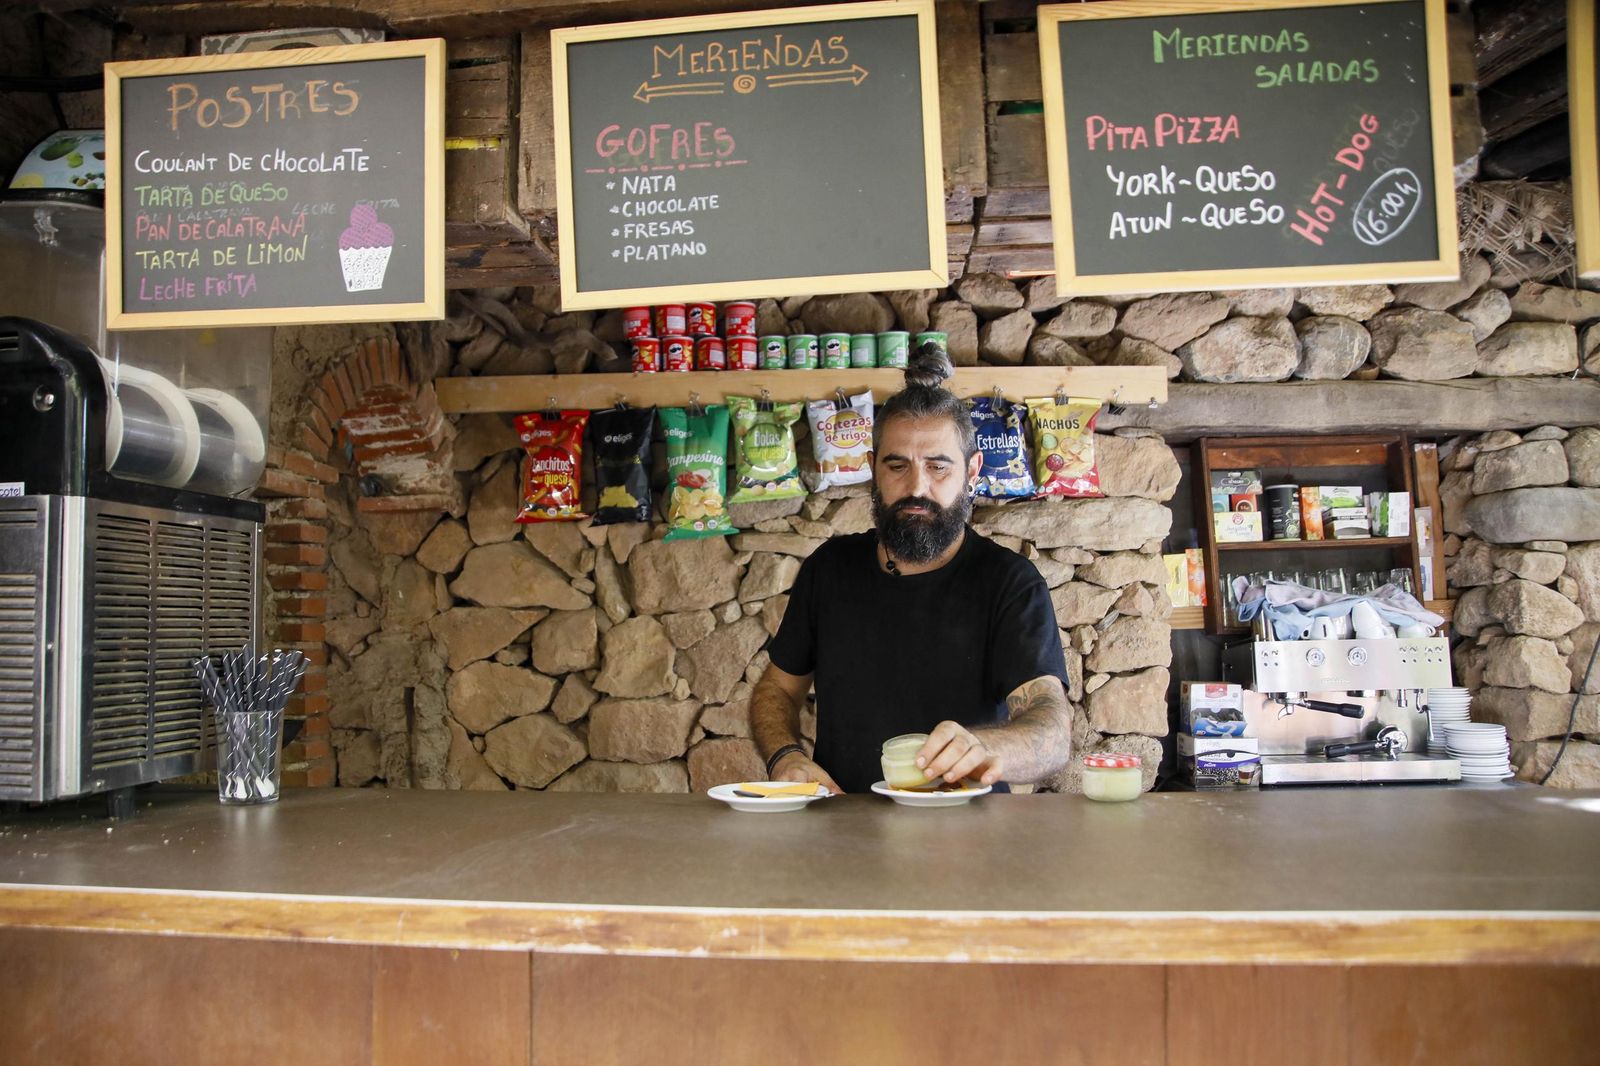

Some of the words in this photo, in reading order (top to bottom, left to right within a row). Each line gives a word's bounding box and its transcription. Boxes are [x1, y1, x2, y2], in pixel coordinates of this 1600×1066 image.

[652, 34, 850, 78] MERIENDAS
[1152, 28, 1309, 64] MERIENDAS
[1255, 58, 1380, 88] SALADAS
[168, 80, 360, 131] POSTRES
[596, 122, 736, 160] GOFRES
[135, 150, 218, 174] COULANT
[229, 152, 252, 172] DE
[260, 147, 370, 173] CHOCOLATE
[134, 186, 193, 206] TARTA
[202, 187, 224, 206] DE
[230, 182, 288, 204] QUESO
[622, 175, 676, 194] NATA
[622, 195, 720, 216] CHOCOLATE
[136, 214, 172, 240] PAN
[179, 224, 202, 240] DE
[206, 212, 305, 240] CALATRAVA
[624, 220, 694, 239] FRESAS
[136, 249, 200, 270] TARTA
[214, 246, 237, 266] DE
[624, 242, 707, 262] PLATANO
[140, 277, 196, 300] LECHE
[816, 416, 872, 431] Cortezas
[825, 434, 838, 442] de
[842, 432, 868, 442] trigo
[977, 432, 1018, 450] Estrellas
